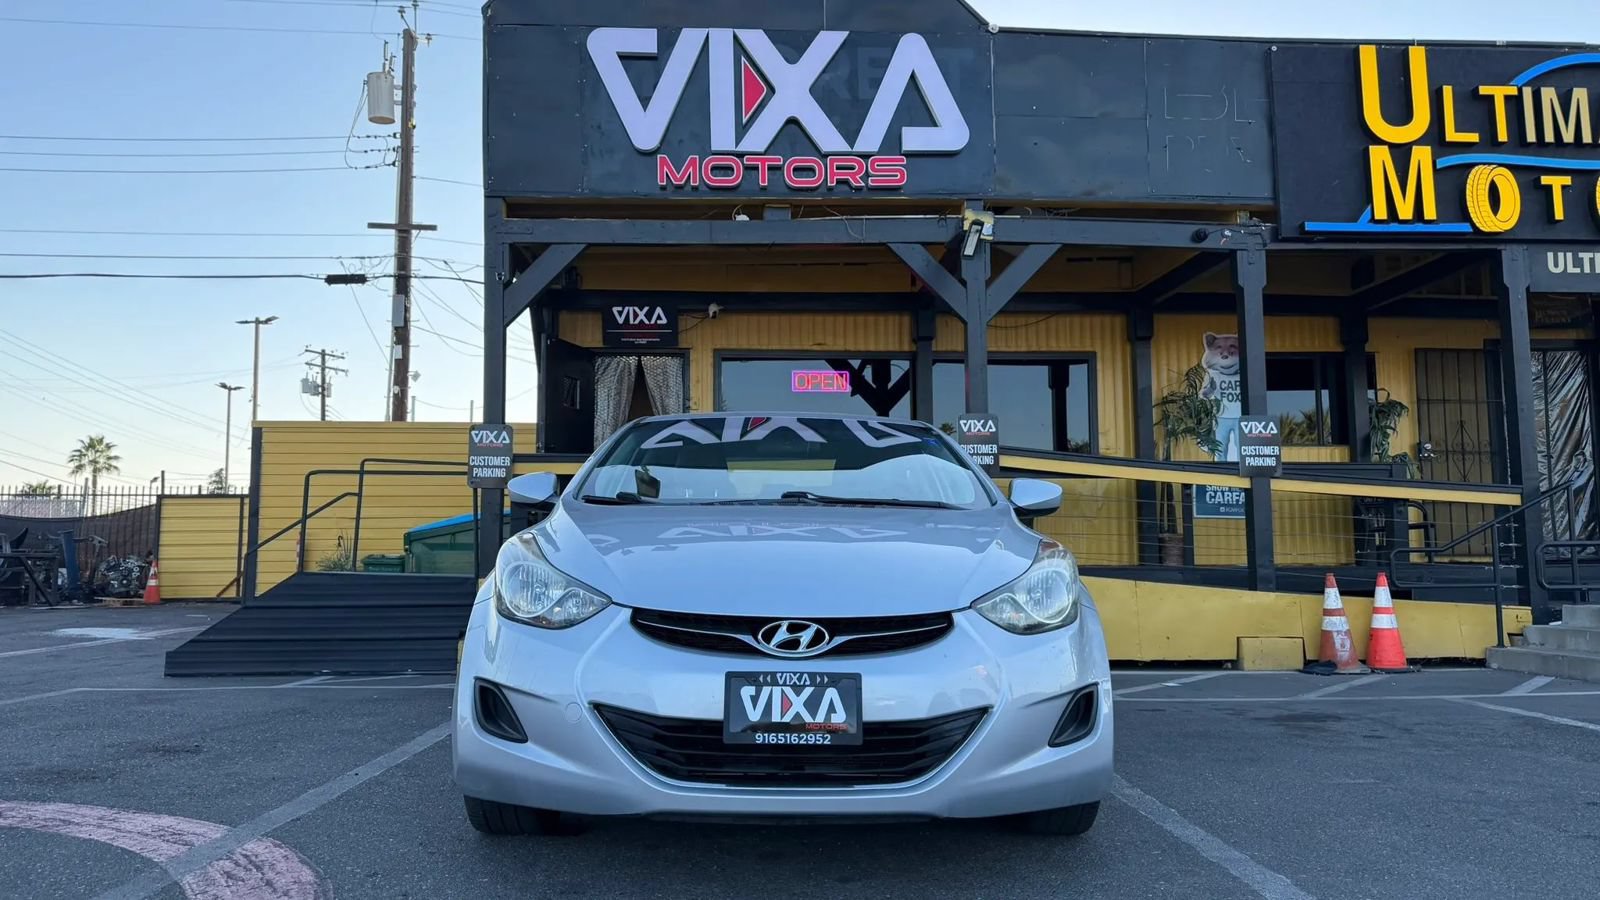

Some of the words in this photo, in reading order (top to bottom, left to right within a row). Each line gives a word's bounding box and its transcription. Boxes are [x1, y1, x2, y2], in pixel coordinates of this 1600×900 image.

[586, 27, 970, 154] VIXA
[1359, 44, 1600, 143] ULTIM
[657, 154, 908, 189] MOTORS
[1369, 145, 1600, 232] MOT
[612, 306, 668, 325] VIXA
[795, 373, 847, 391] OPEN
[1220, 391, 1242, 403] FOX
[959, 419, 996, 432] VIXA
[1240, 421, 1277, 433] VIXA
[471, 430, 510, 443] VIXA
[1241, 445, 1279, 455] CUSTOMER
[469, 455, 510, 465] CUSTOMER
[1245, 456, 1276, 466] PARKING
[473, 467, 506, 477] PARKING
[776, 672, 811, 685] VIXA
[740, 685, 847, 723] VIXA
[805, 723, 849, 731] MOTORS
[755, 733, 831, 745] 9165162952
